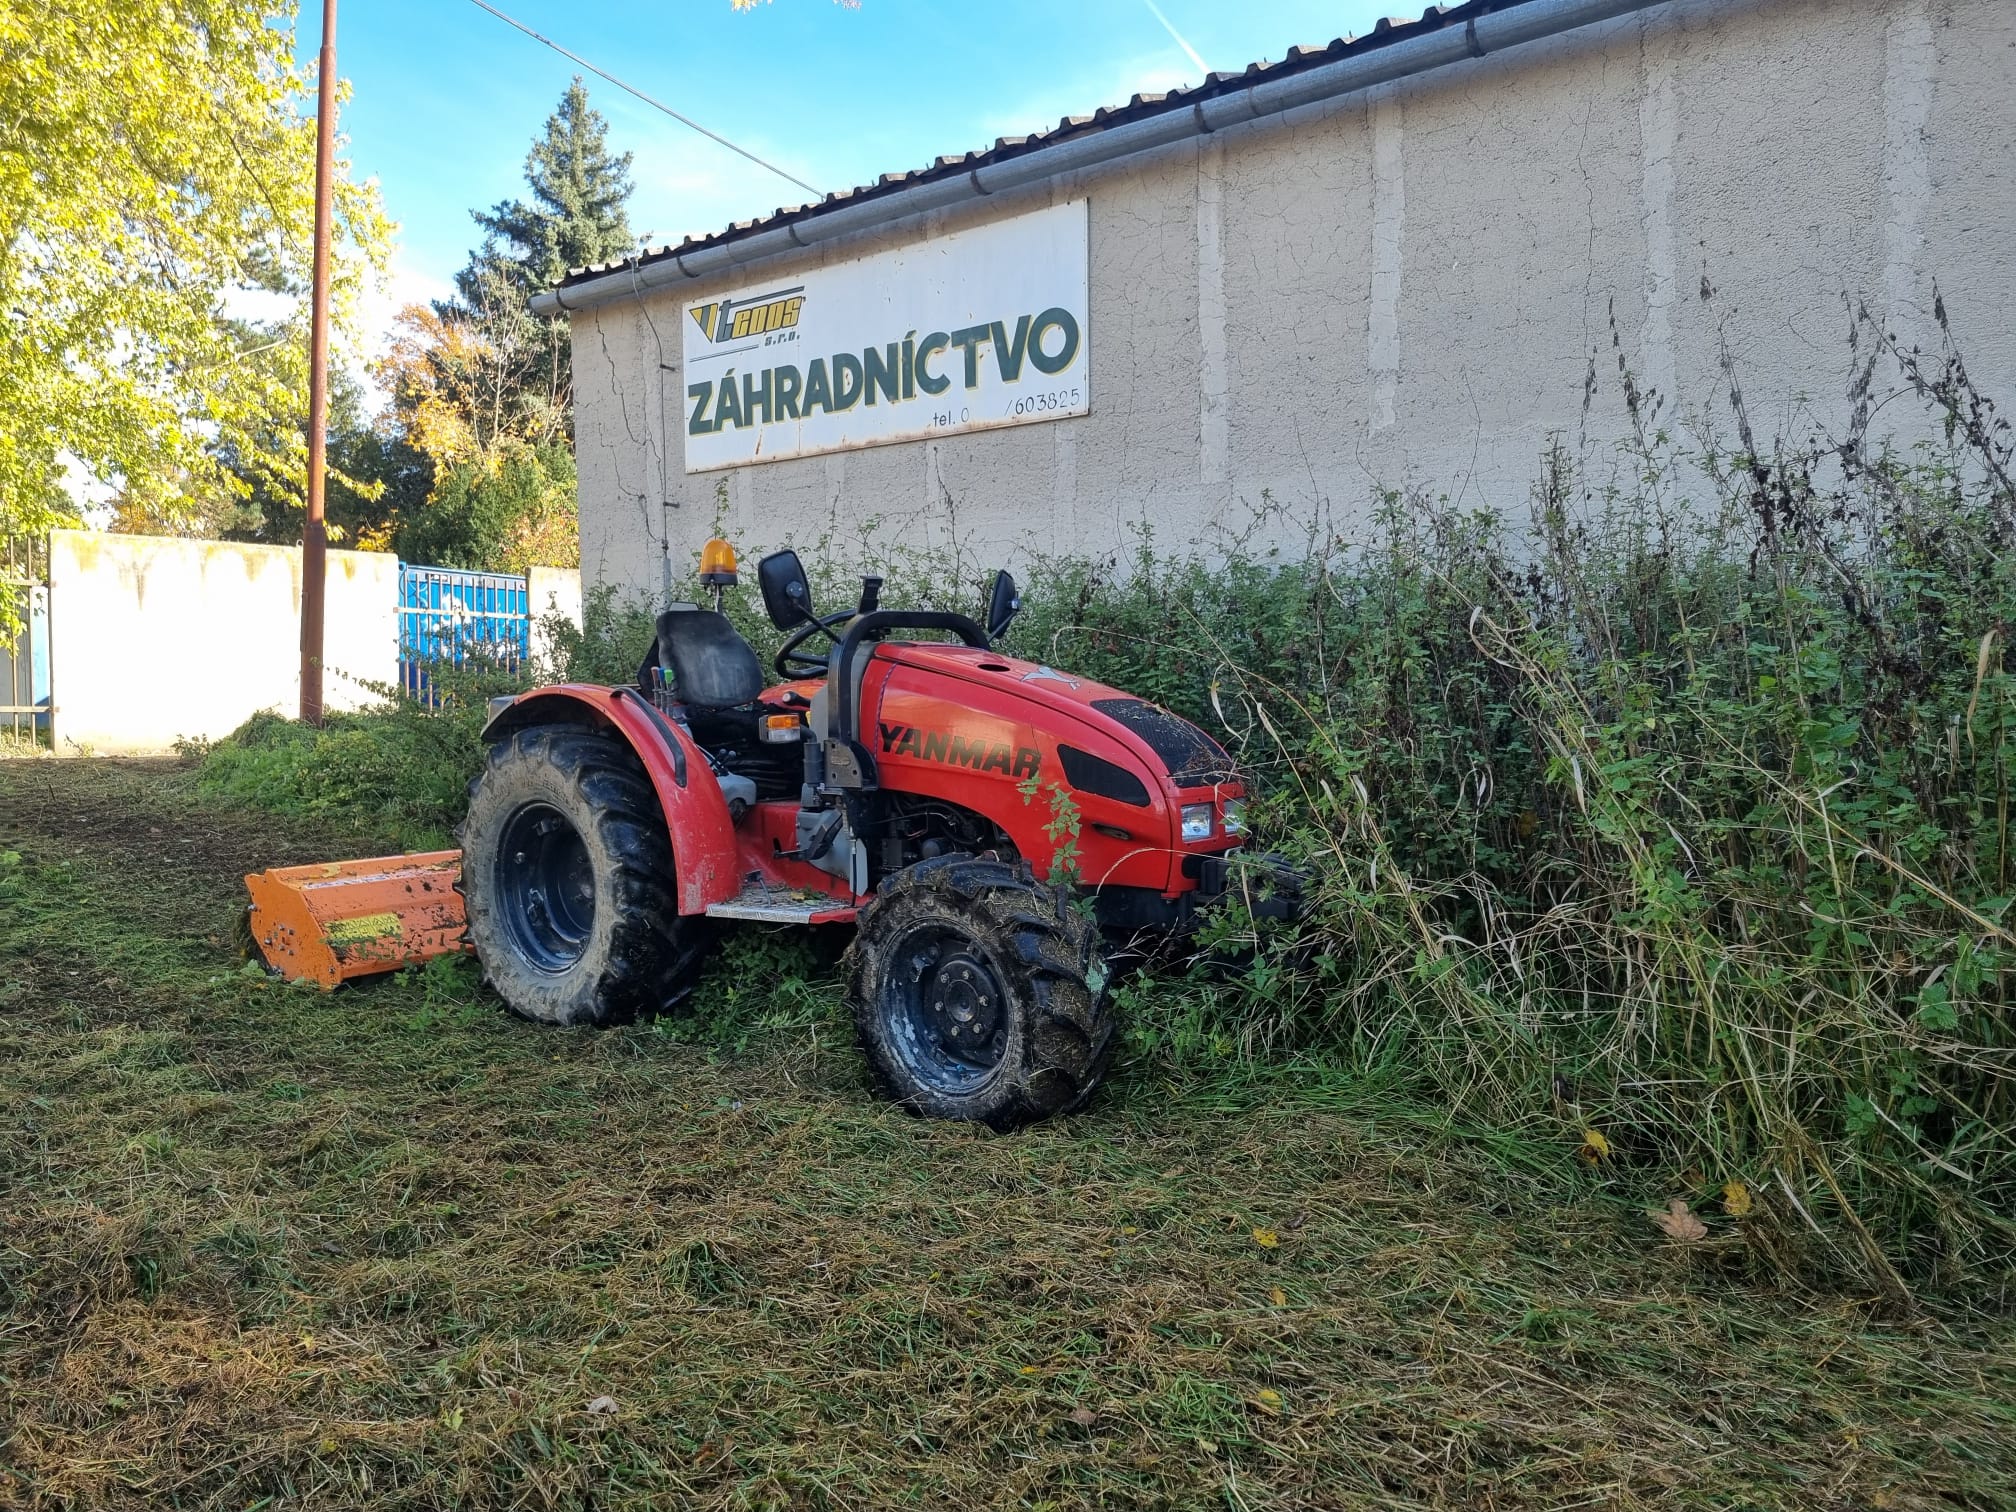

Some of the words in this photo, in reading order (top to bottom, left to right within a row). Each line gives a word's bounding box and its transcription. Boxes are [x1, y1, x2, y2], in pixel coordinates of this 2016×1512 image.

[688, 307, 1081, 436] ZÁHRADNÍCTVO
[933, 410, 956, 428] tel.
[879, 723, 1041, 780] YANMAR
